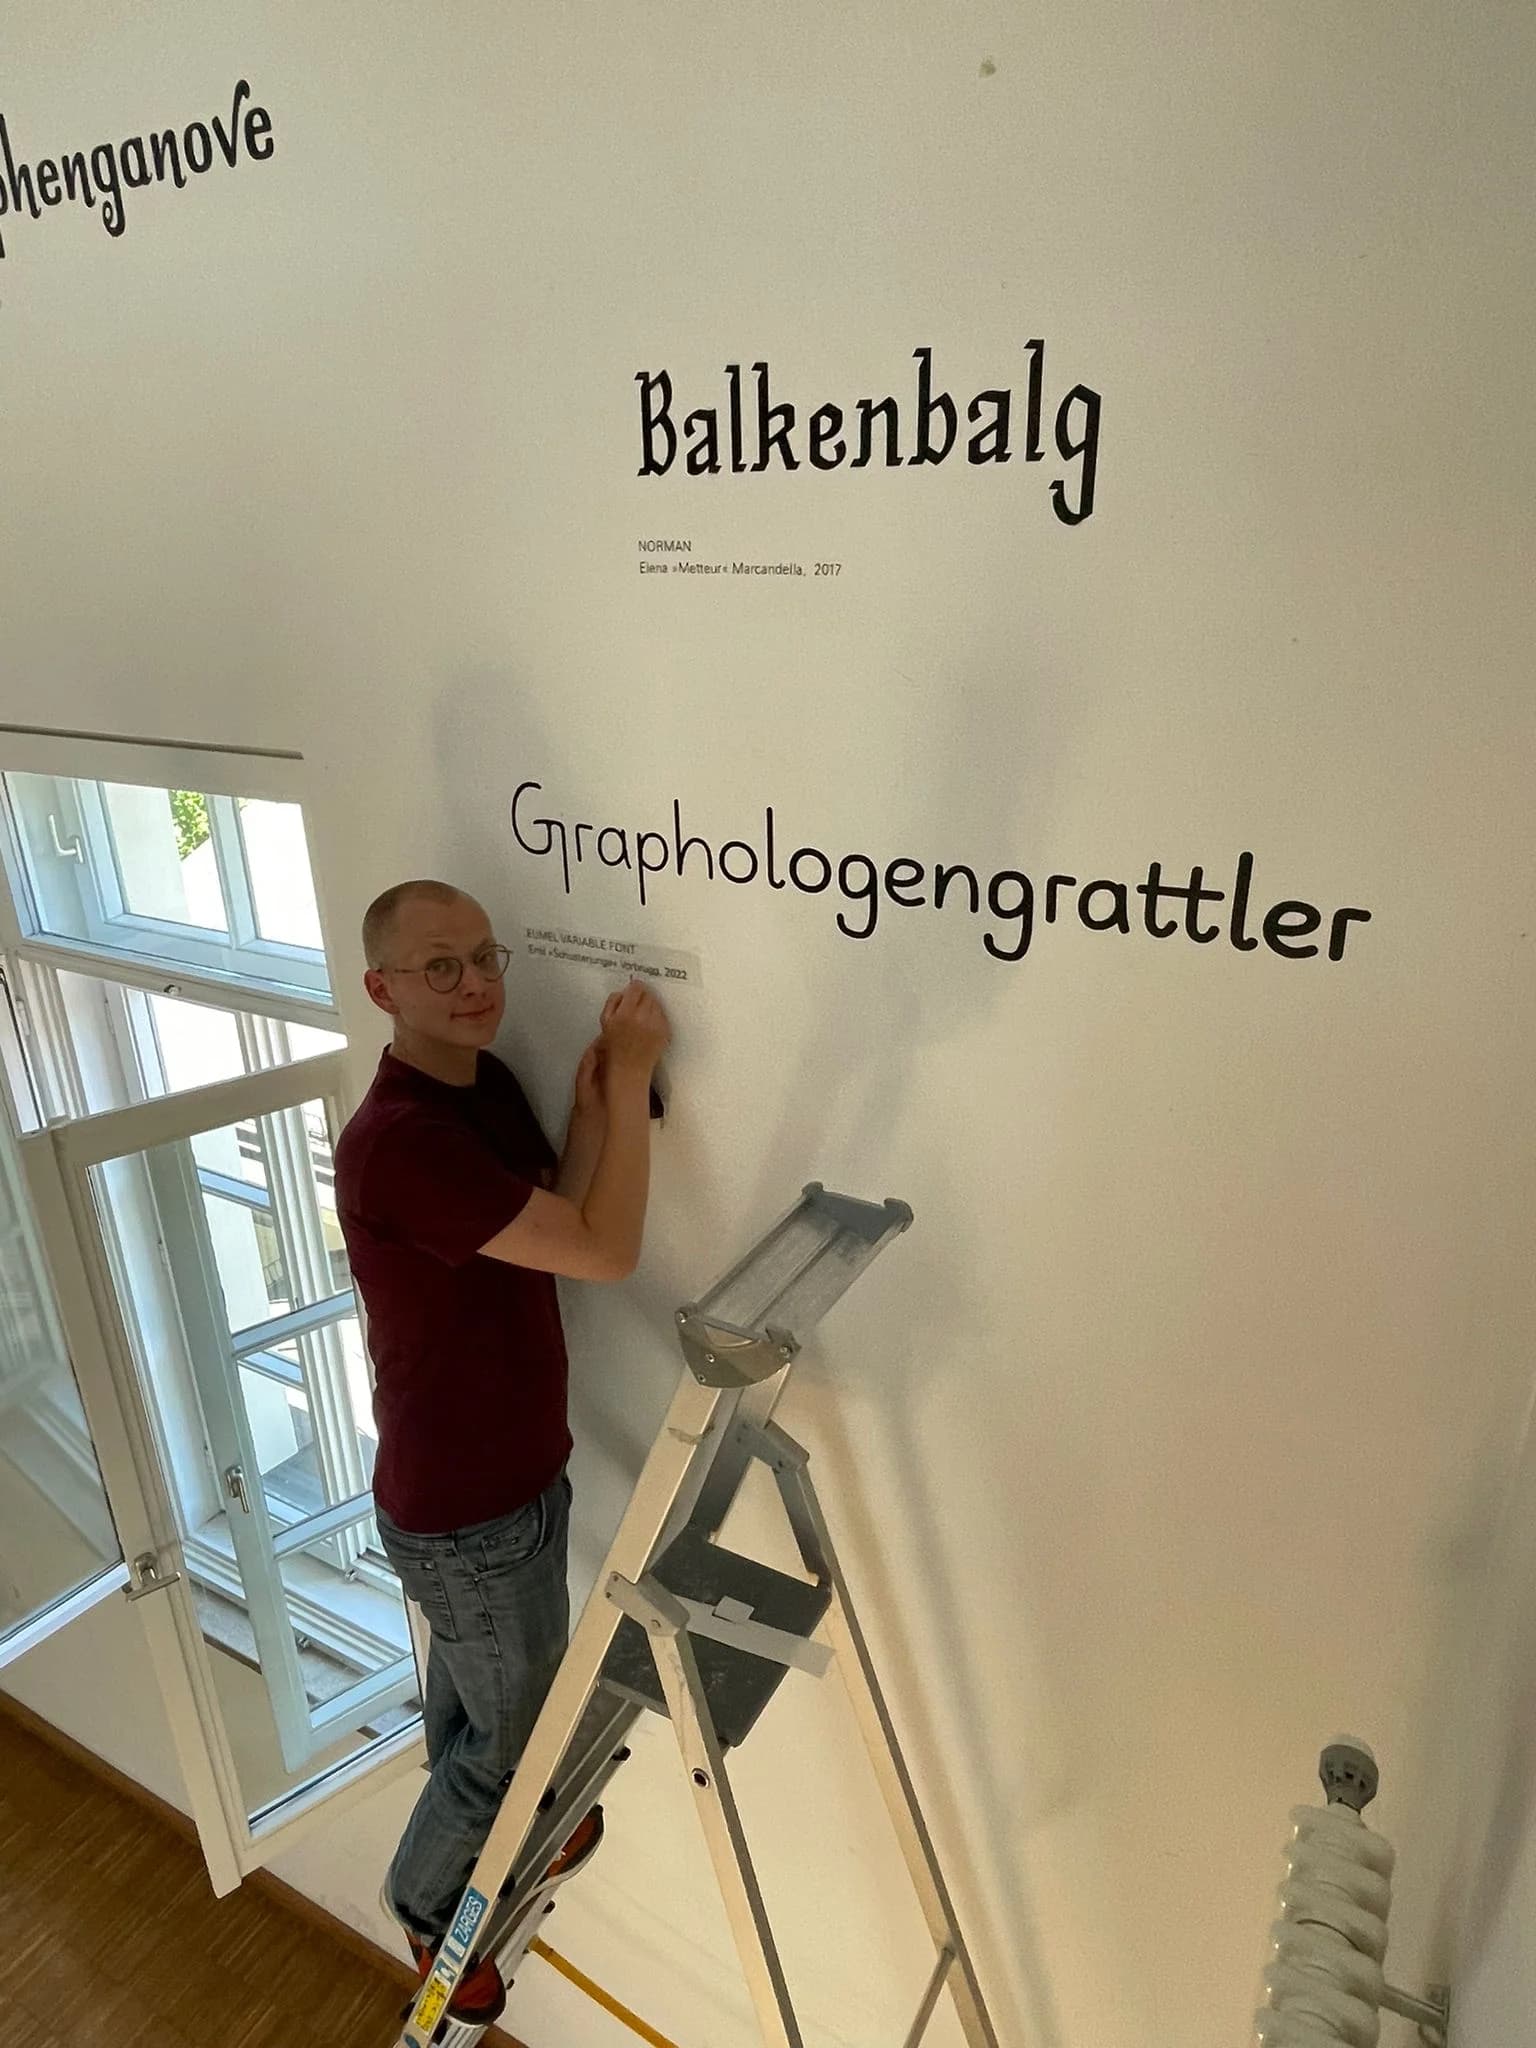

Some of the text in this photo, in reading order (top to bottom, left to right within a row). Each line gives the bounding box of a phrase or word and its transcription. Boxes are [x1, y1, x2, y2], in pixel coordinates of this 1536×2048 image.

[0, 79, 274, 259] henganove
[634, 339, 1102, 526] Balkenbalg
[638, 540, 692, 552] NORMAN
[639, 561, 668, 574] Elena
[814, 563, 842, 576] 2017
[511, 781, 1373, 962] Graphologengrattler
[560, 933, 607, 950] VARIABLE
[608, 941, 636, 955] FONT
[663, 966, 688, 981] 2022
[454, 1895, 482, 1943] ZARGES
